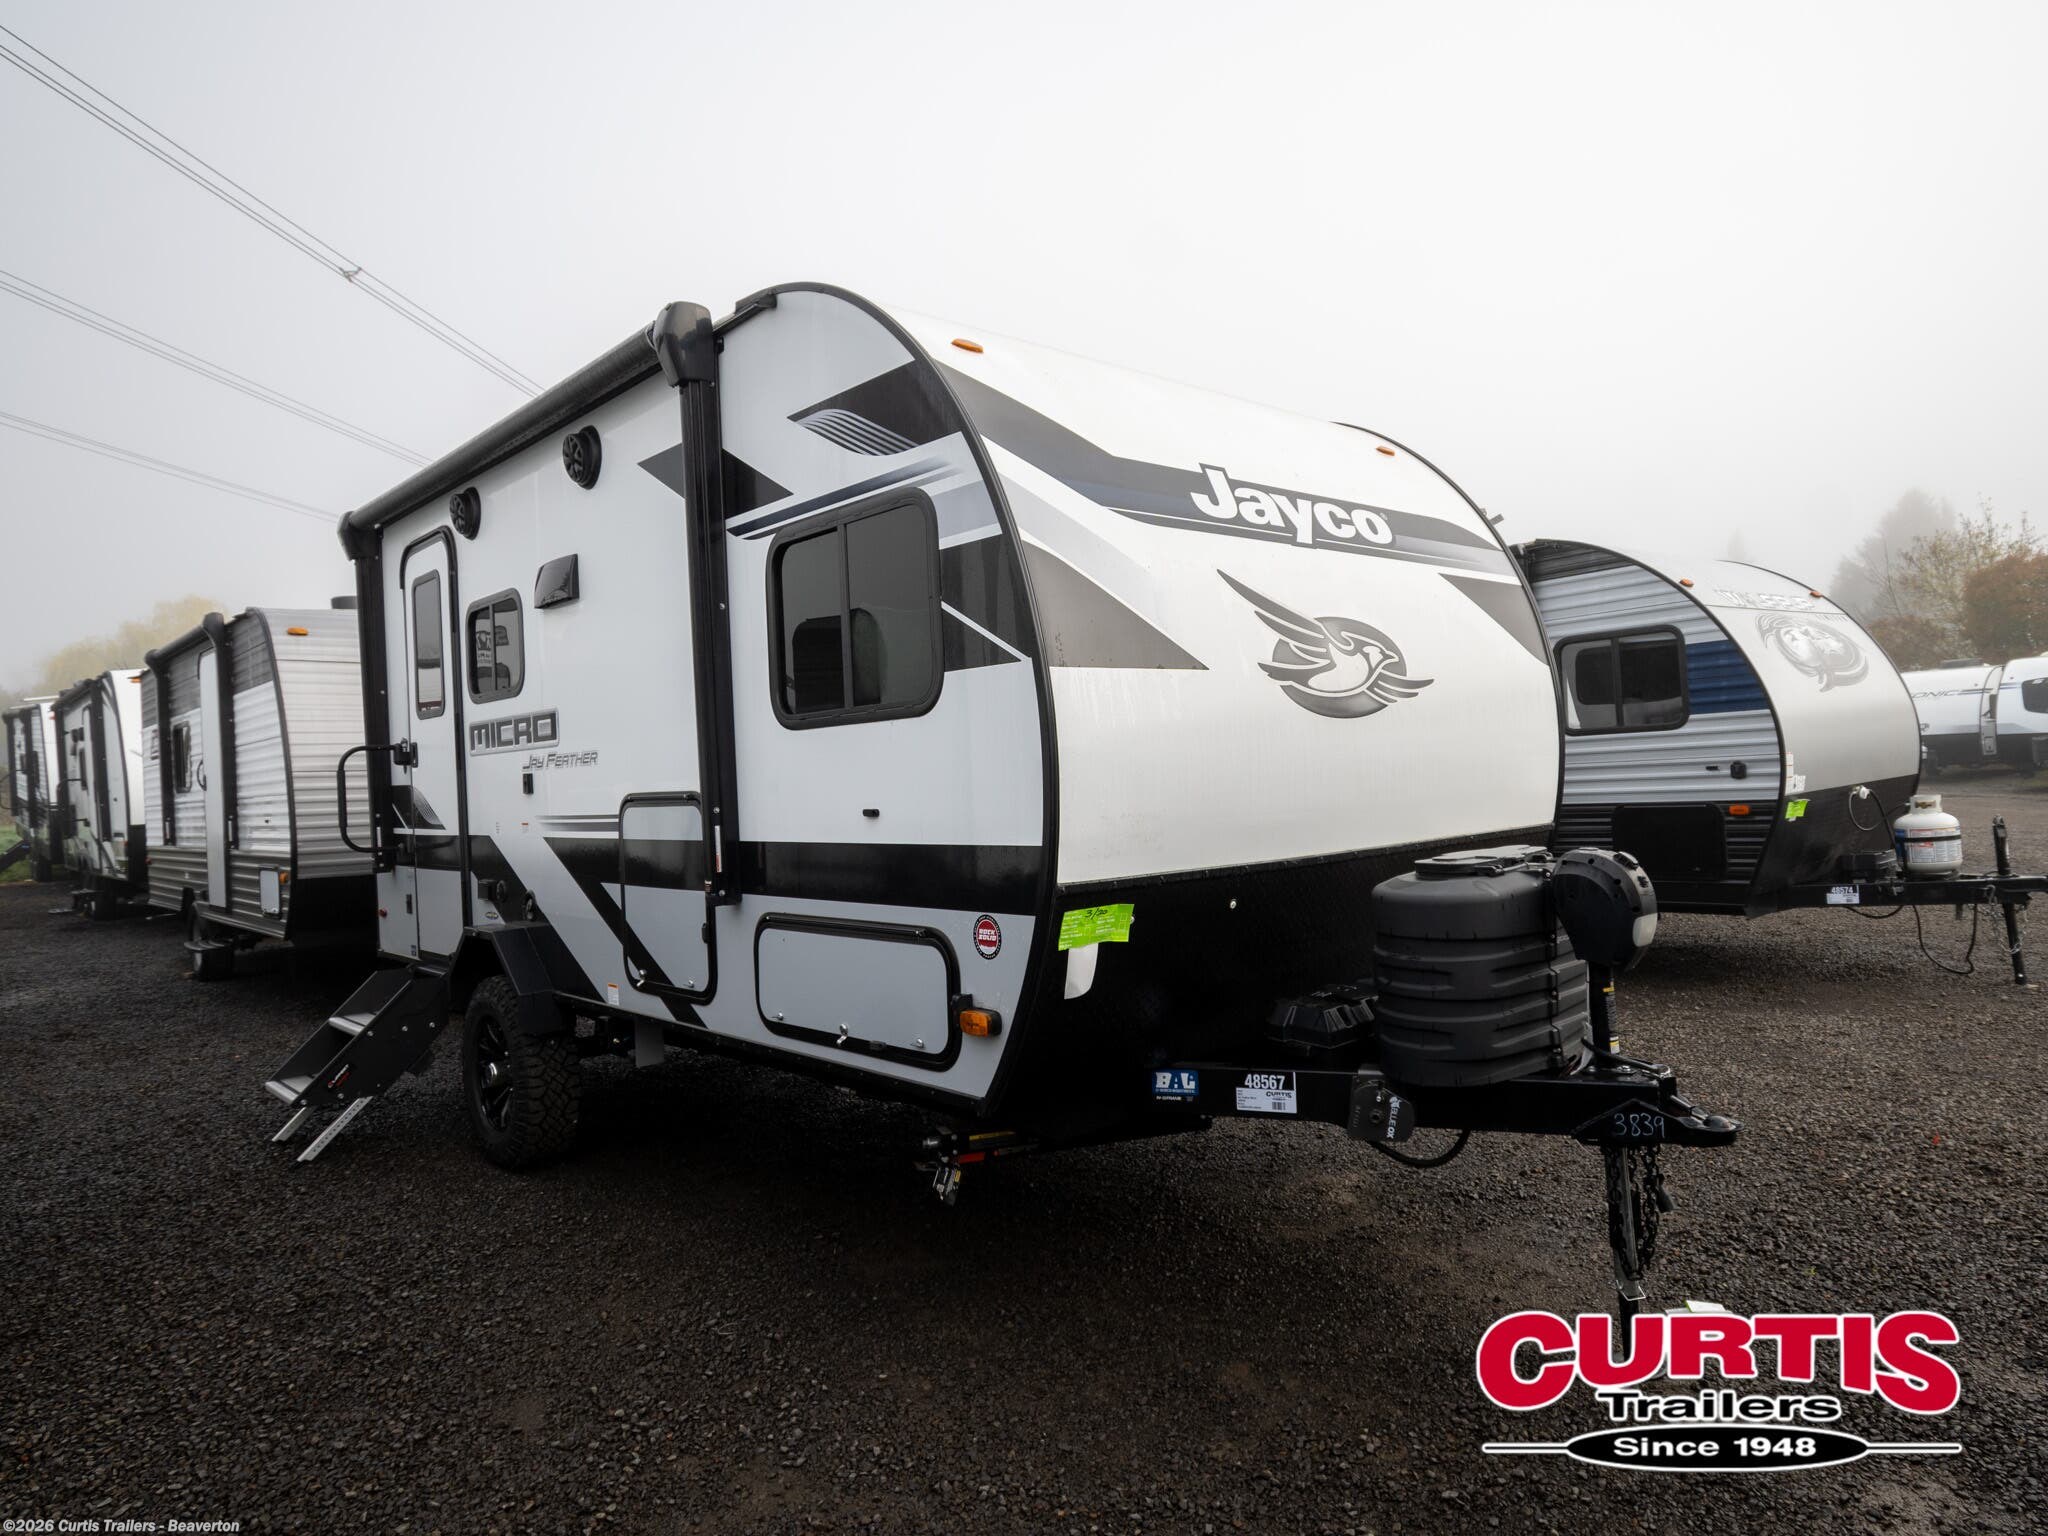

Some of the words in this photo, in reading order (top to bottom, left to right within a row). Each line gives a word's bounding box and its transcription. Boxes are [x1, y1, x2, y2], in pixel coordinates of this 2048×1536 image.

[1190, 467, 1392, 544] Jayco
[1911, 689, 1959, 699] ONIC
[470, 712, 557, 751] MICRO
[1244, 1073, 1286, 1090] 48567
[1265, 1090, 1293, 1099] CURTIS
[1613, 1112, 1665, 1138] 3839
